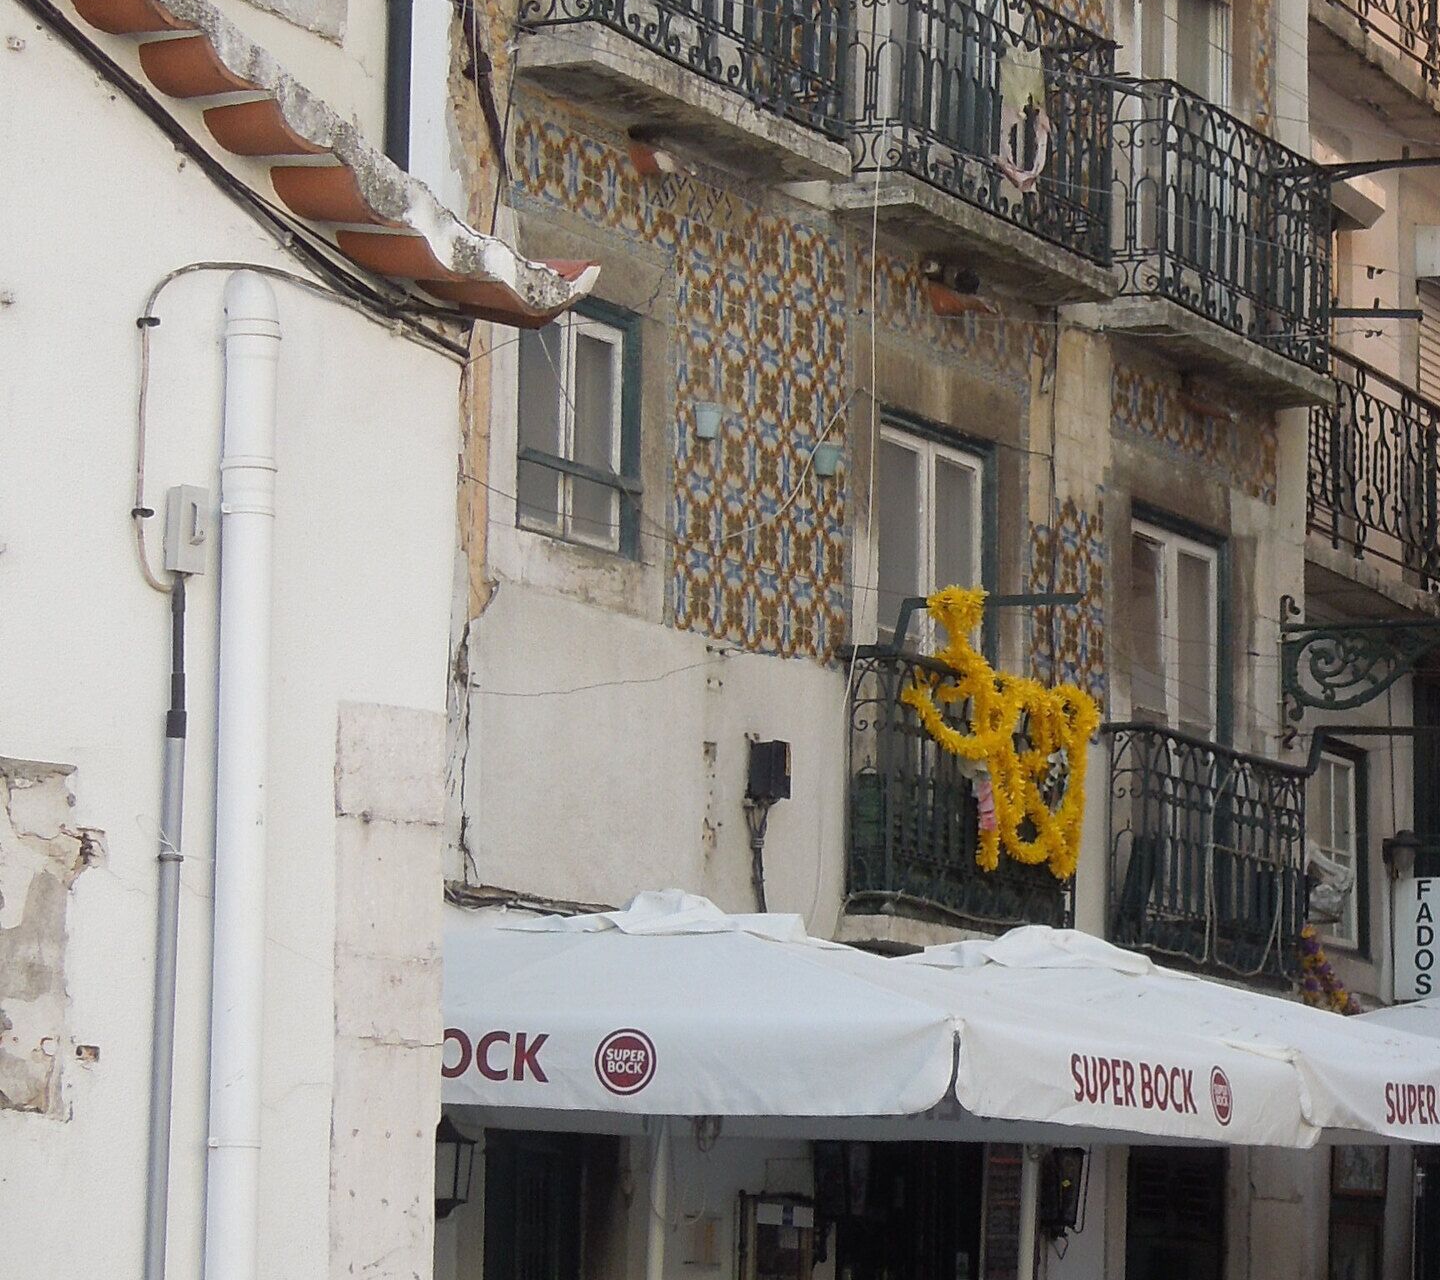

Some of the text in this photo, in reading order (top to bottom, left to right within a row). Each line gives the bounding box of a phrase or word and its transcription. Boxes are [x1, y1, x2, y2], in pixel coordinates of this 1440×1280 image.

[1415, 880, 1434, 995] FADOS
[605, 1048, 645, 1063] SUPER
[607, 1061, 643, 1074] BOCK
[1071, 1053, 1198, 1114] SUPER BOCK
[1385, 1082, 1440, 1125] SUPER
